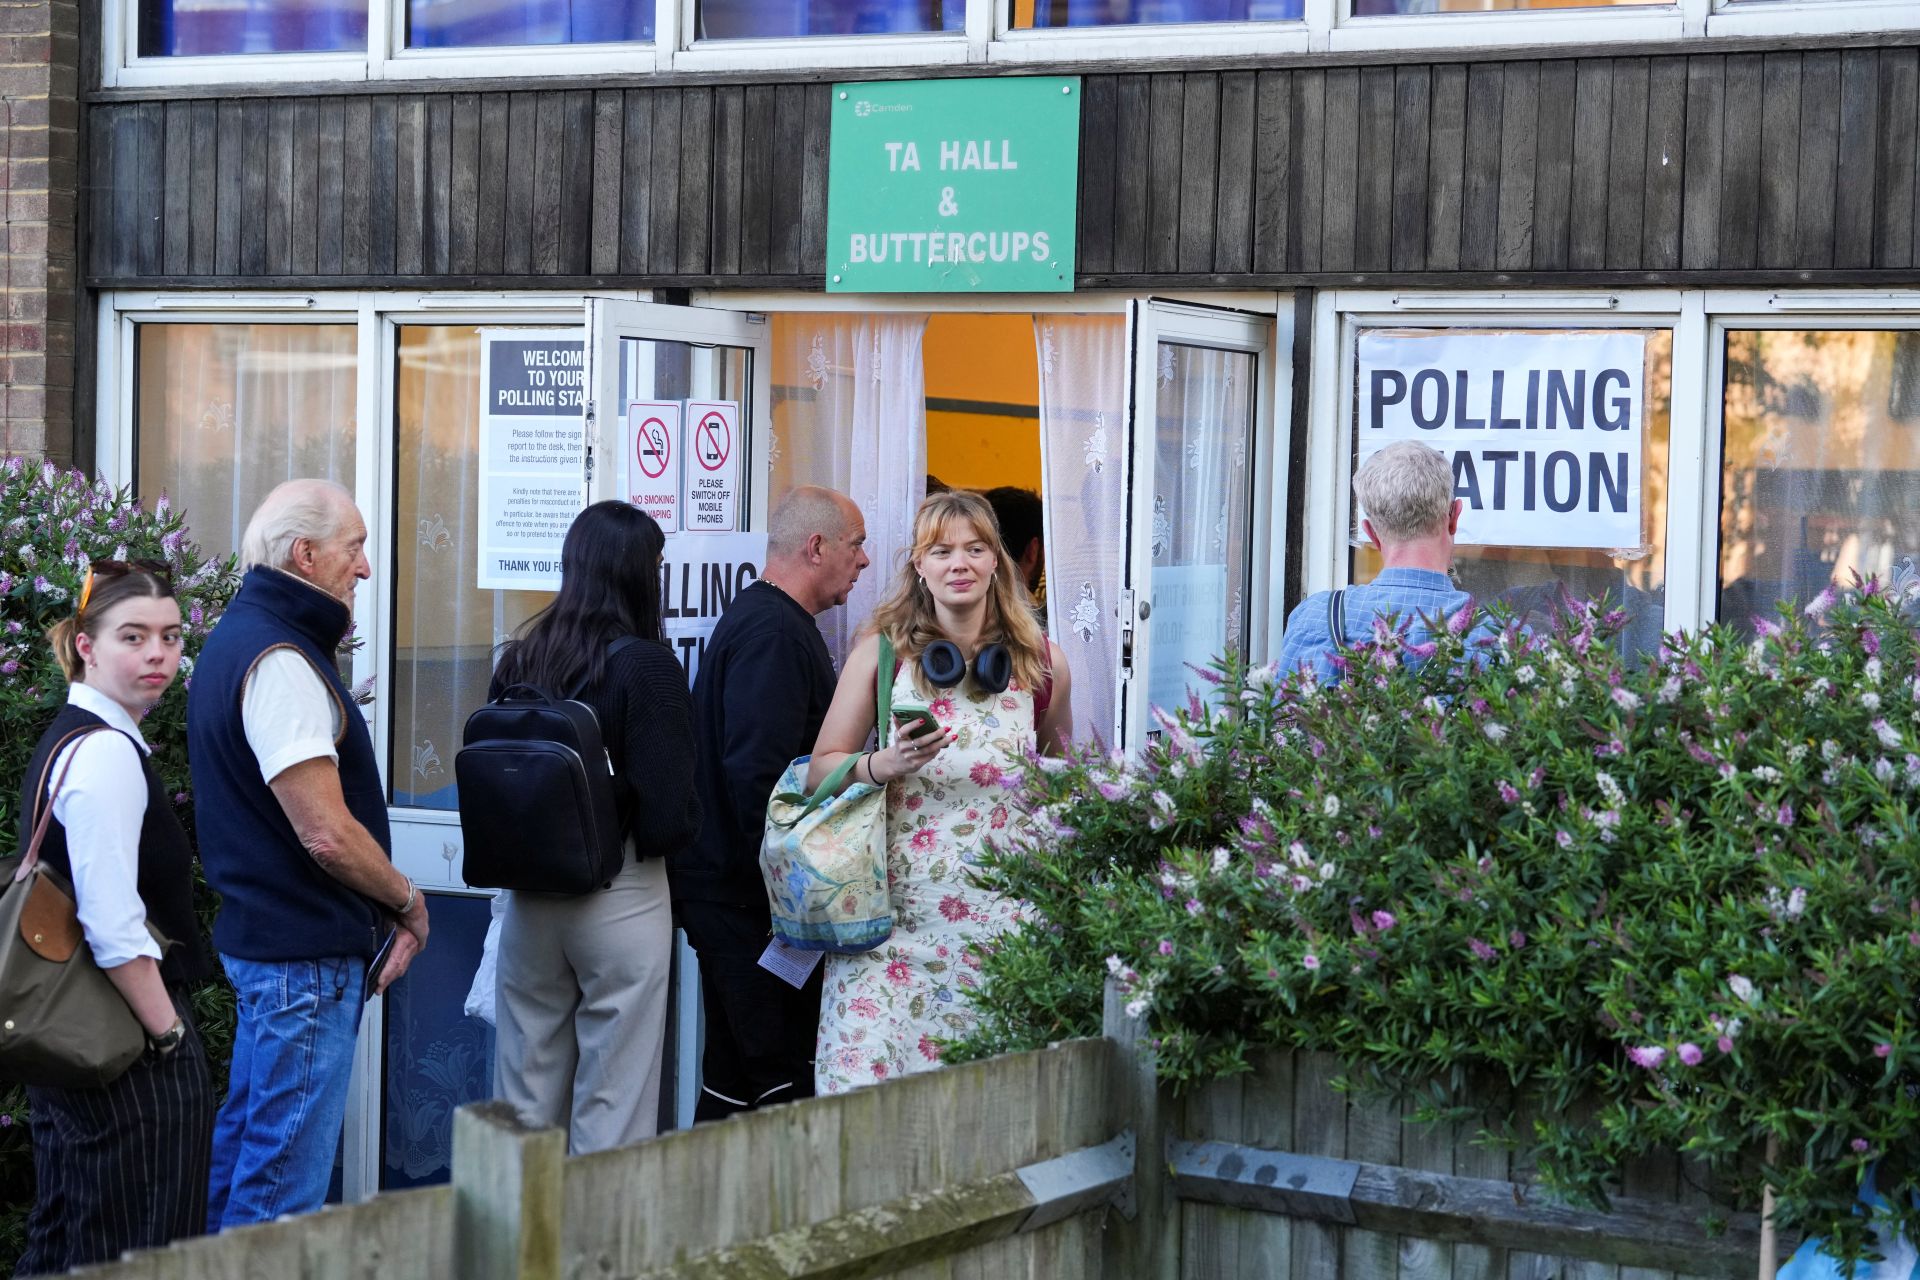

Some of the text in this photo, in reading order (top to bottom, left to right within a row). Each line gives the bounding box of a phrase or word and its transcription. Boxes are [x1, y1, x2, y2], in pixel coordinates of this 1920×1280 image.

[871, 103, 913, 113] Camden
[884, 140, 1018, 172] TA HALL
[938, 186, 959, 217] &
[850, 231, 1050, 263] BUTTERCUPS
[523, 350, 584, 367] WELCOM
[528, 370, 584, 387] TO YOUR
[498, 389, 583, 407] POLLING STA
[1370, 368, 1632, 431] POLLING
[512, 429, 533, 438] Please
[535, 430, 554, 438] follow
[555, 430, 566, 438] the
[508, 442, 582, 452] report to the desk, then
[509, 454, 520, 462] the
[521, 454, 558, 463] instructions
[559, 456, 577, 465] given
[698, 479, 724, 488] PLEASE
[1451, 450, 1629, 513] ATION
[512, 488, 528, 496] Kindly
[541, 488, 553, 496] that
[691, 491, 731, 500] SWITCH OFF
[507, 498, 531, 506] penalties
[632, 495, 675, 505] NO SMOKING
[698, 502, 723, 512] MOBILE
[697, 514, 724, 523] PHONES
[498, 559, 530, 571] THANK
[532, 560, 551, 572] YOU
[663, 562, 757, 618] LLIN
